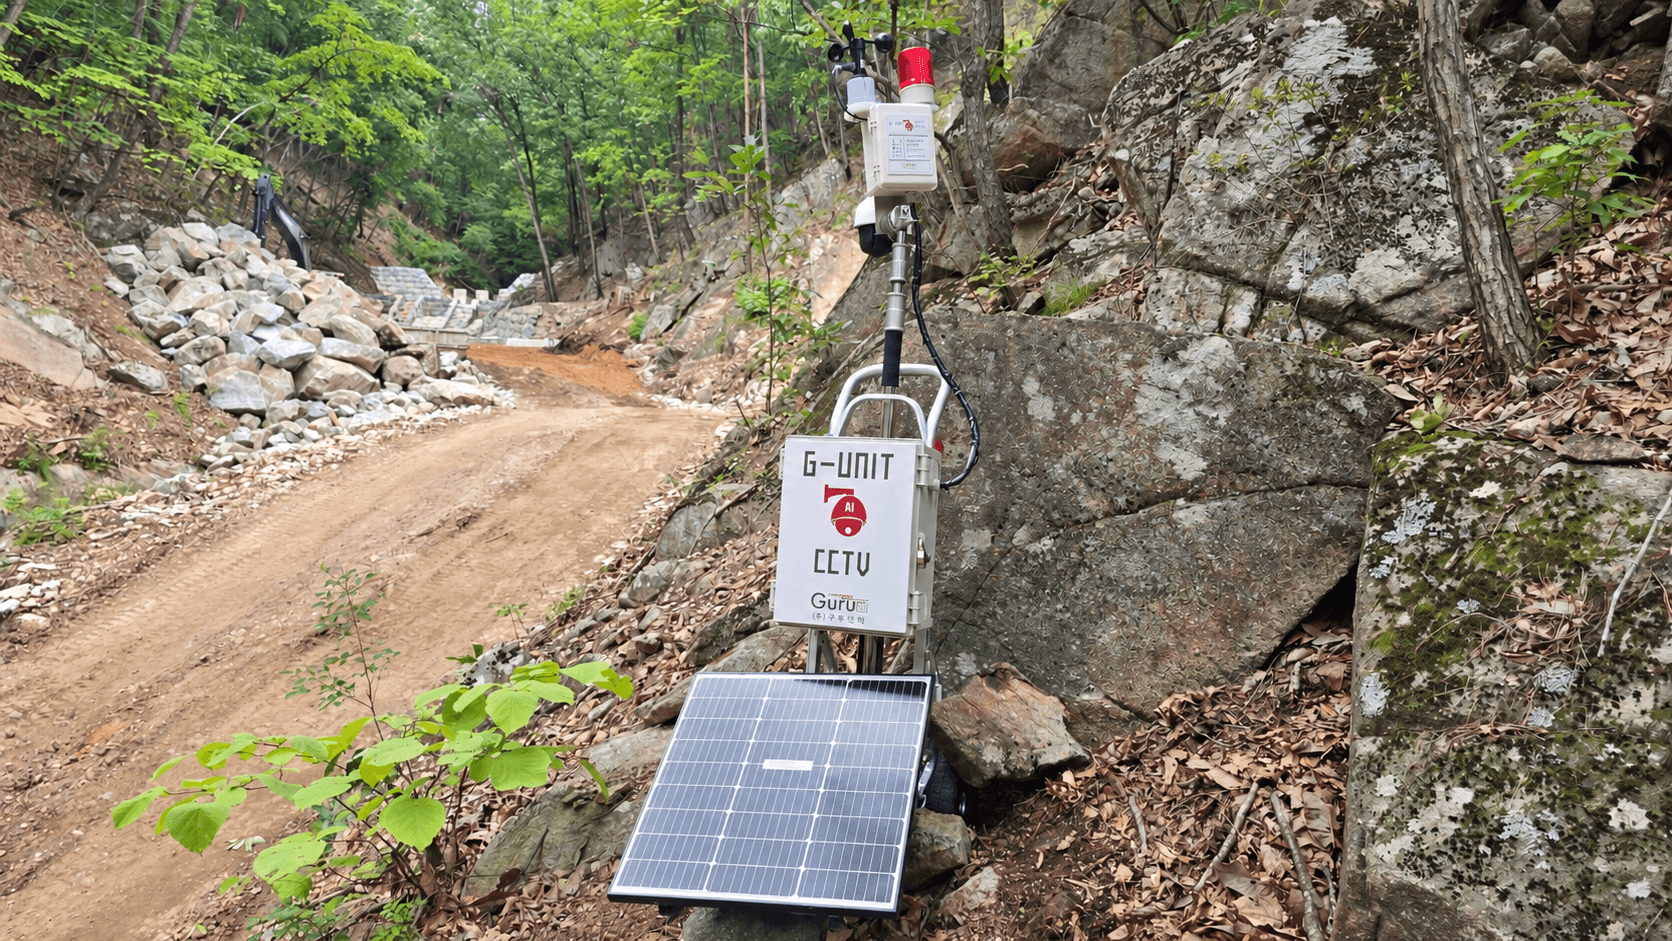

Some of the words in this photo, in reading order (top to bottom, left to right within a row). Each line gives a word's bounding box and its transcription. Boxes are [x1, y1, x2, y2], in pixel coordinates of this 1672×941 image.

[803, 451, 894, 480] G-UNIT
[844, 502, 855, 513] AI
[813, 548, 870, 577] CCTV
[811, 592, 855, 612] Guru
